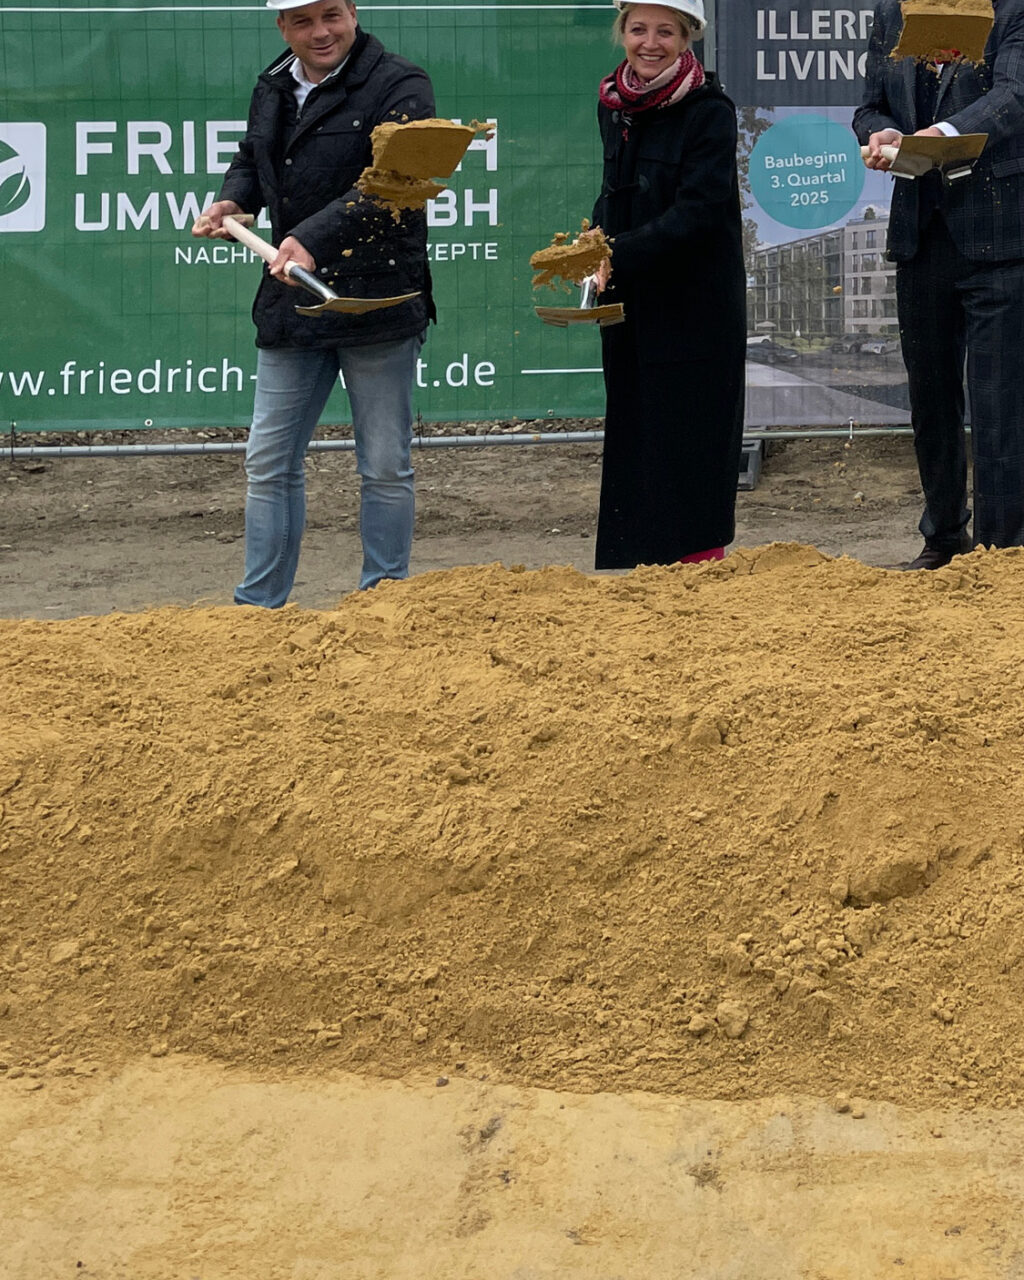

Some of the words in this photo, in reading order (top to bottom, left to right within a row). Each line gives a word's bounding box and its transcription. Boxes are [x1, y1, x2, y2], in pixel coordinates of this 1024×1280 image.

[765, 151, 847, 169] Baubeginn
[771, 175, 785, 189] 3.
[787, 168, 846, 187] Quartal
[790, 190, 829, 207] 2025
